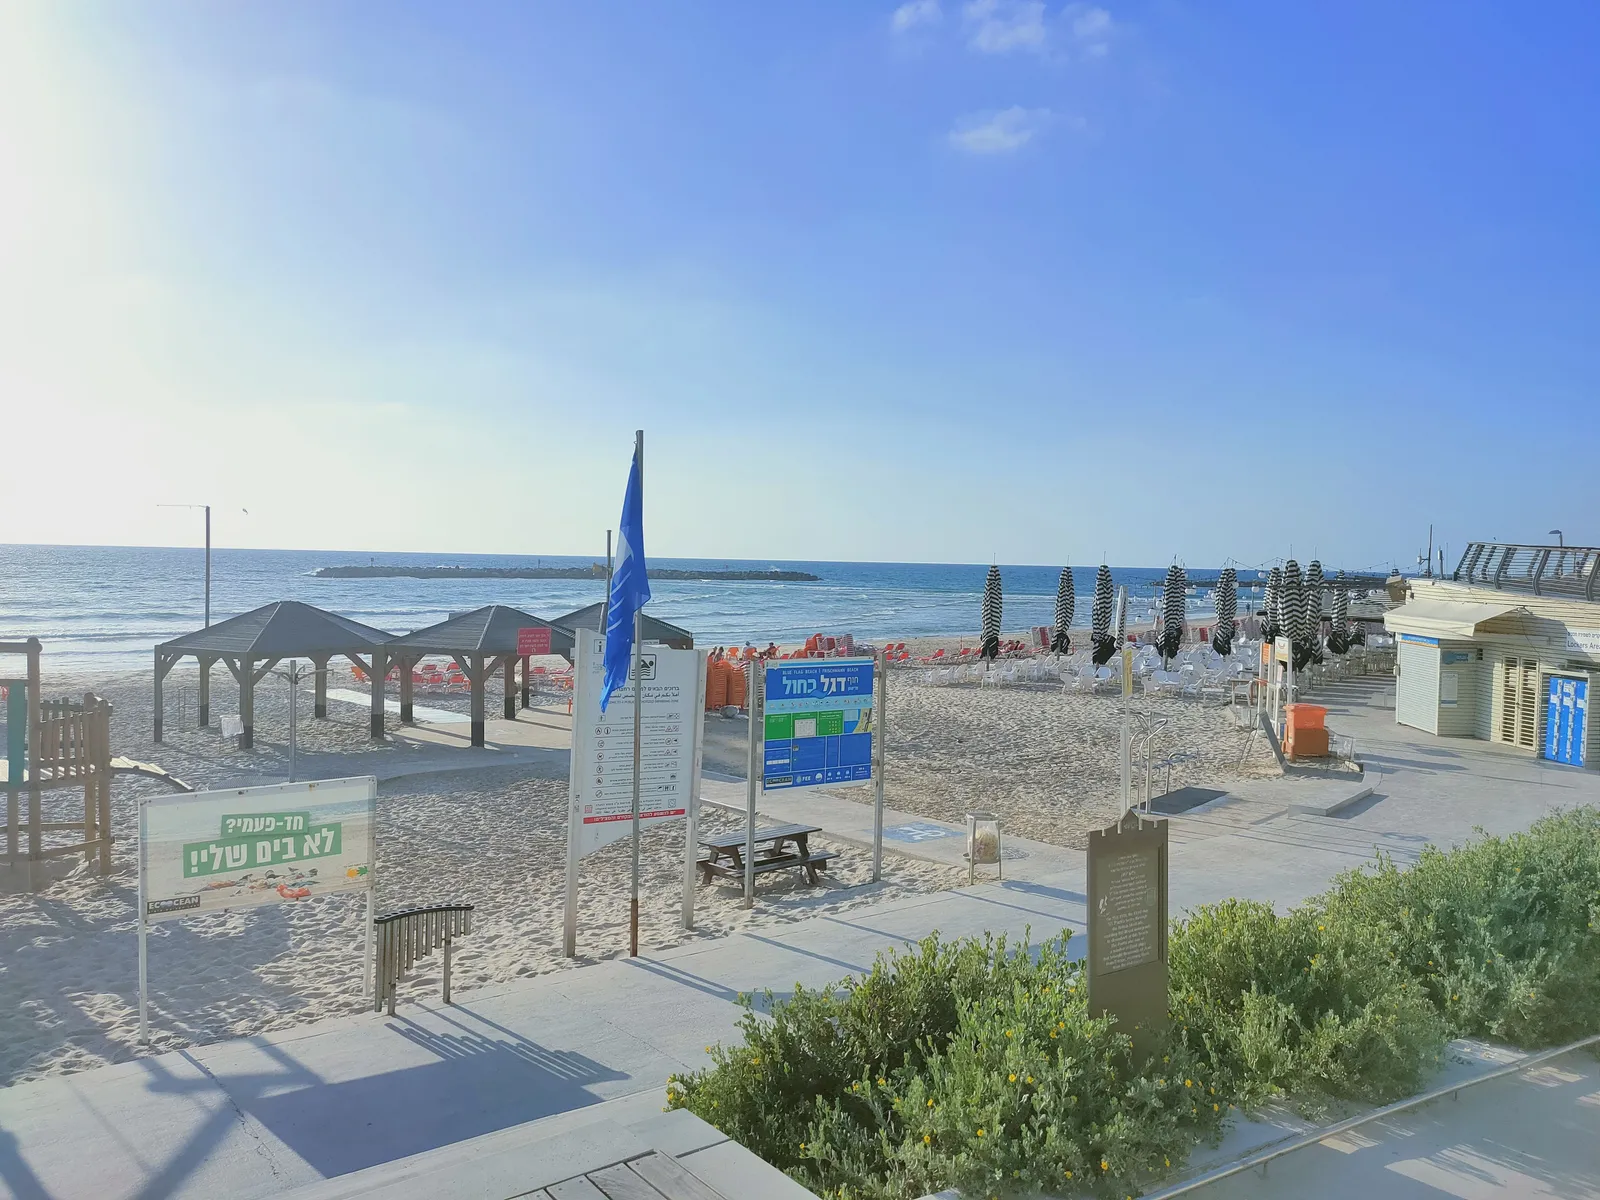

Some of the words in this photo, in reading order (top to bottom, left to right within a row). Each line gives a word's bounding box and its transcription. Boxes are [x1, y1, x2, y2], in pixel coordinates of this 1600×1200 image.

[1567, 640, 1588, 649] Lockers
[782, 676, 817, 695] כחול
[820, 674, 846, 695] דגל
[226, 814, 304, 833] חד-פעמי?
[256, 837, 297, 864] בים
[303, 827, 335, 856] לא
[190, 842, 248, 874] שלי!
